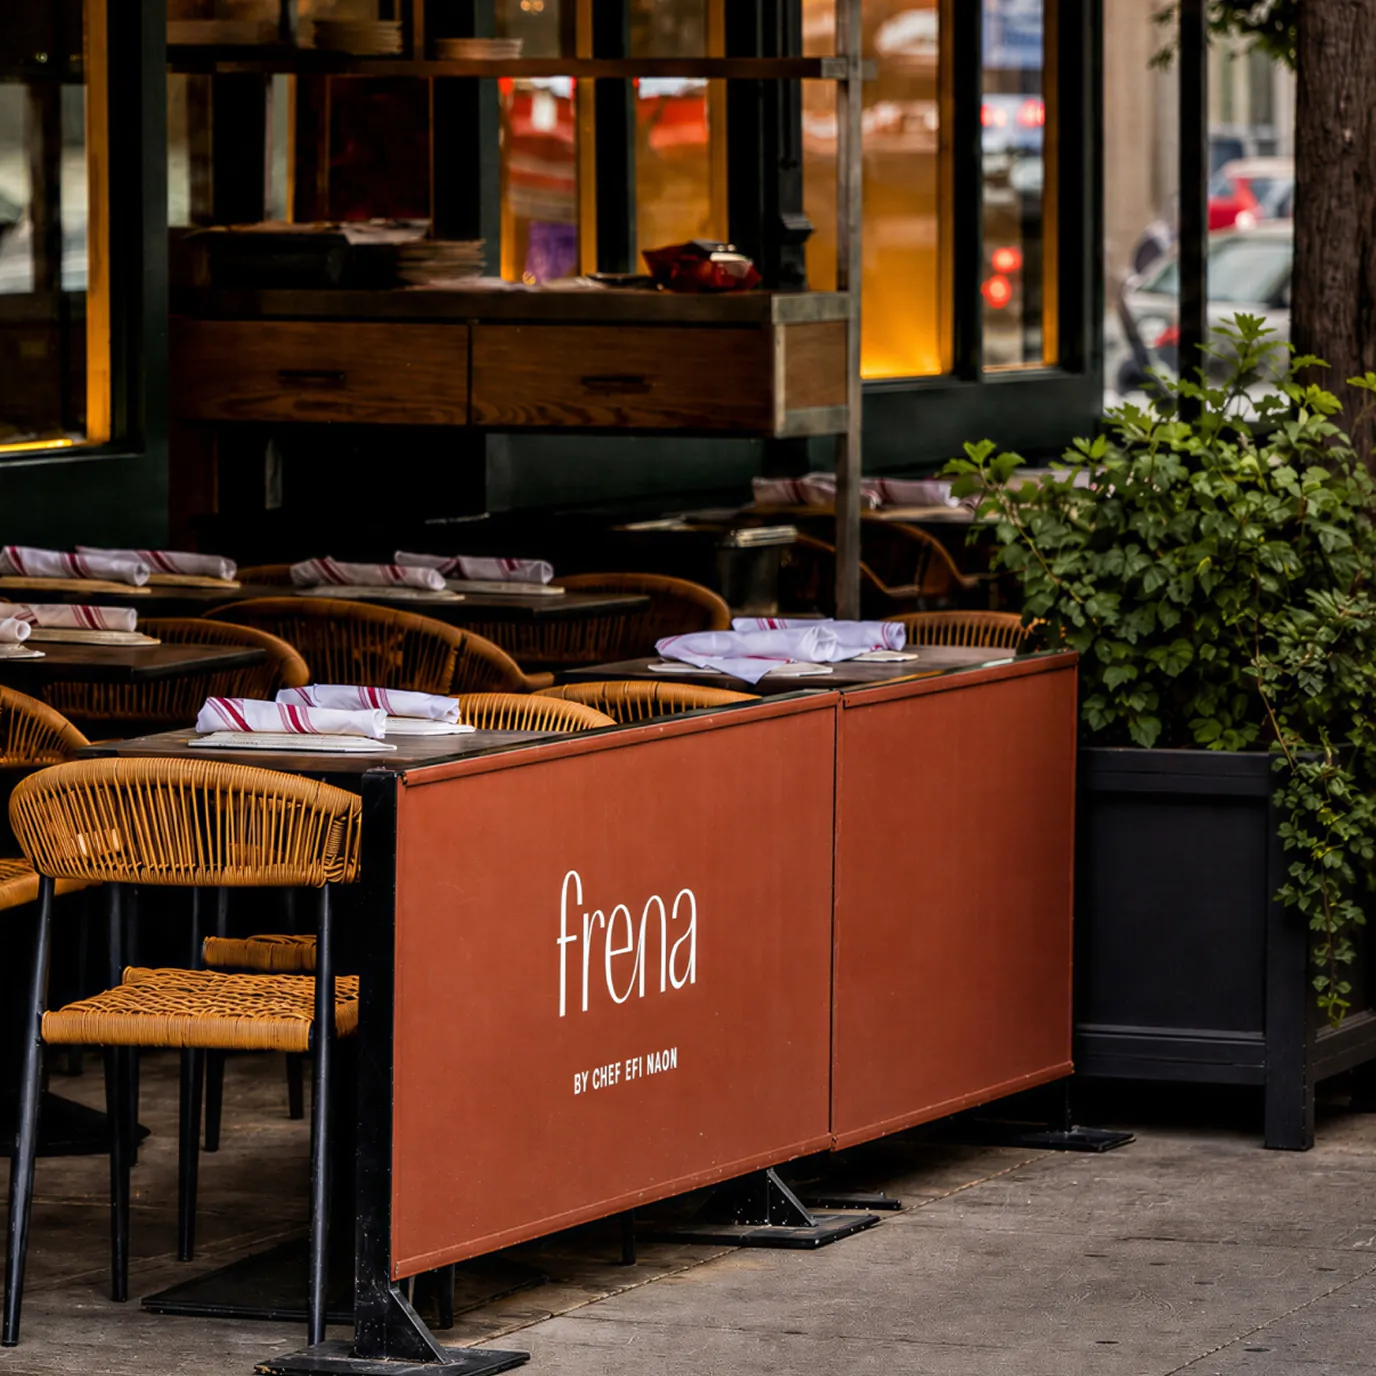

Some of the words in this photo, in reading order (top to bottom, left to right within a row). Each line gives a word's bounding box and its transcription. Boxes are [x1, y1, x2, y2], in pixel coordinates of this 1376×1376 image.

[556, 869, 697, 1017] frena
[574, 1071, 589, 1095] BY
[592, 1062, 621, 1090] CHEF
[625, 1056, 642, 1081] EFI
[646, 1047, 677, 1075] NAON
